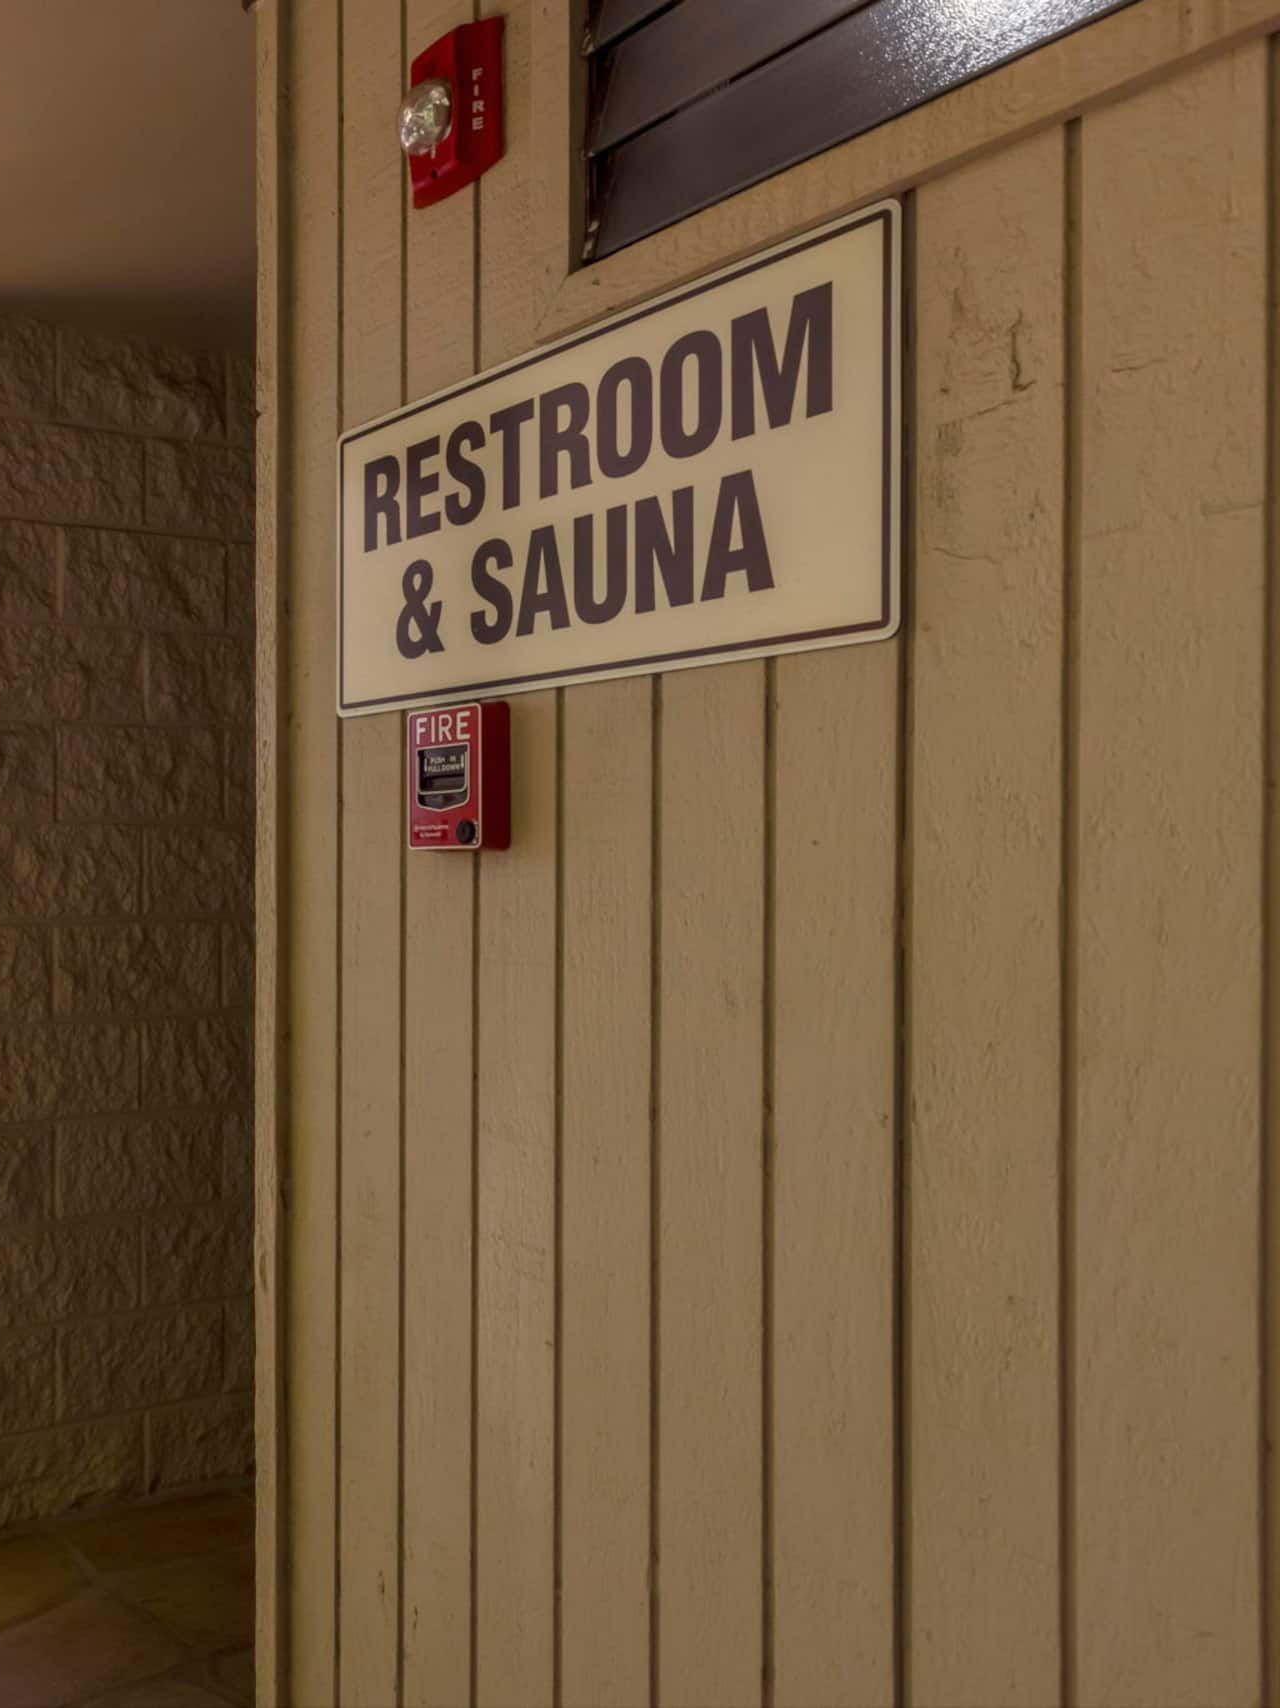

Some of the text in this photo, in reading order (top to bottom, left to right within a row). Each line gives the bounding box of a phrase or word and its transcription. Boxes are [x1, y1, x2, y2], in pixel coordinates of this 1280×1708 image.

[472, 68, 485, 130] FIRE
[363, 281, 833, 553] RESTROOM
[396, 469, 776, 659] & SAUNA
[416, 711, 470, 744] FIRE
